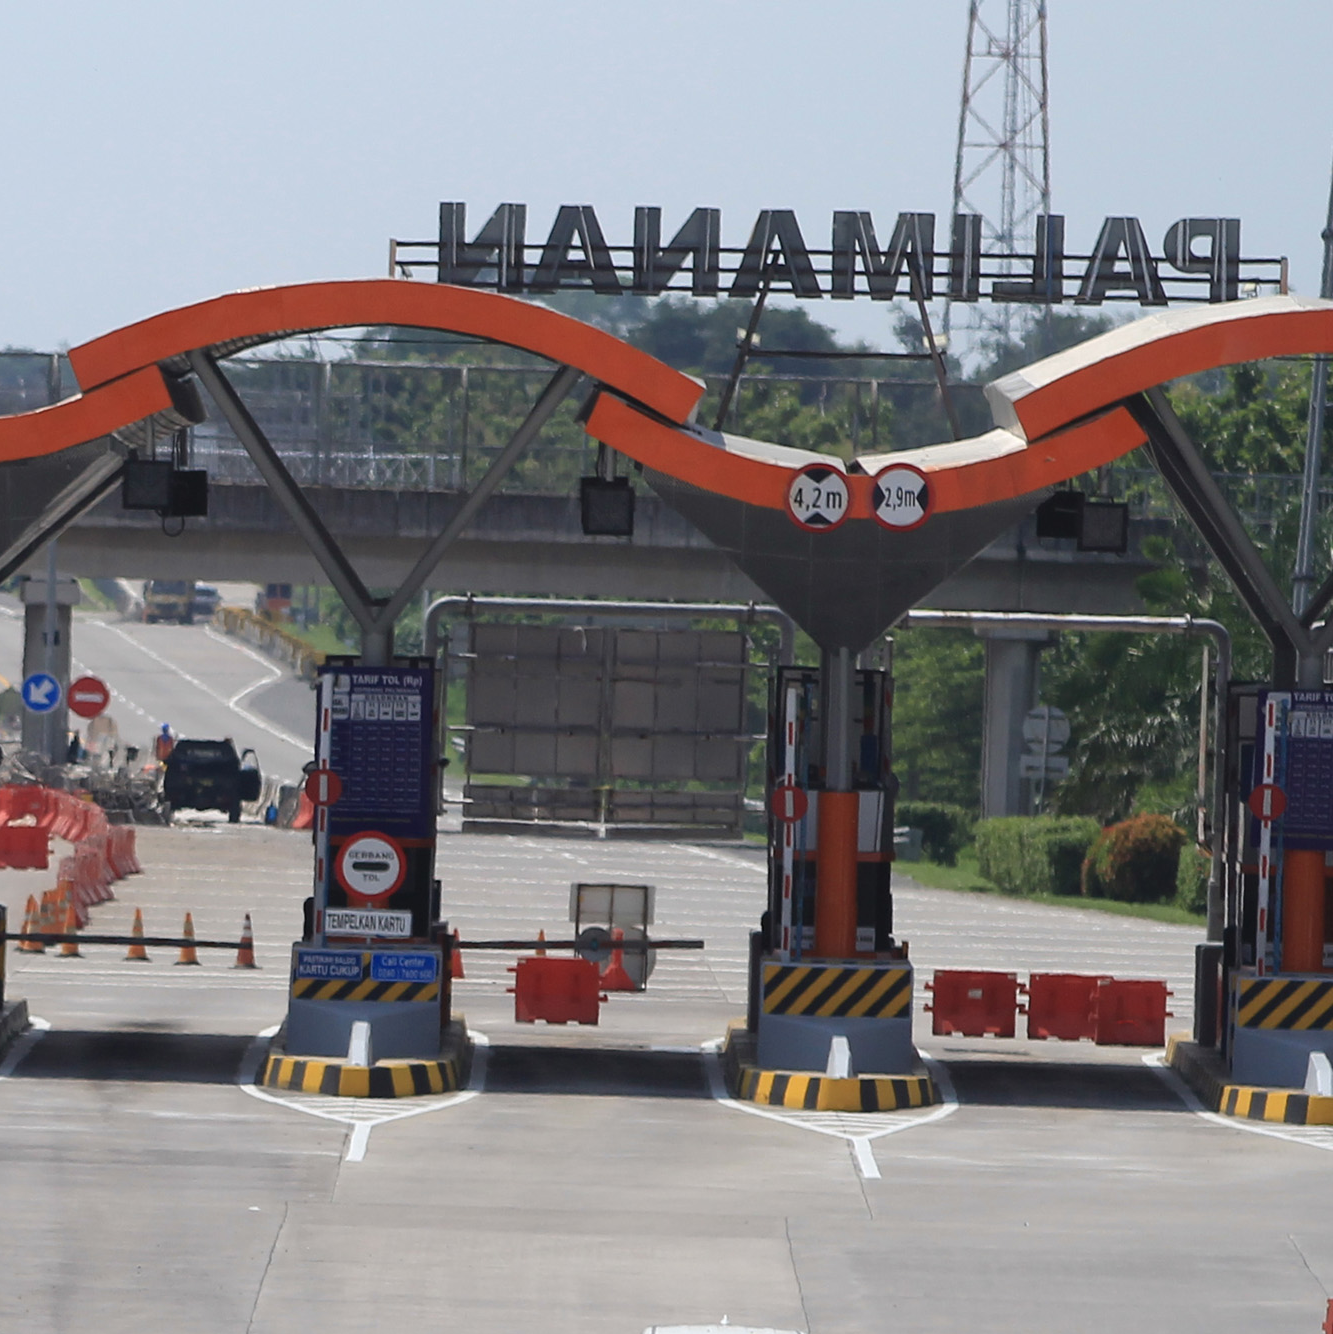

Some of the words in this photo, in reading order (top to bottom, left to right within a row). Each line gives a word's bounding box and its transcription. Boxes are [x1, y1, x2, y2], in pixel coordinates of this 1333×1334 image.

[352, 675, 380, 685] TARIF
[382, 676, 400, 686] TOL
[403, 676, 422, 686] (Rp)
[348, 852, 394, 860] GERBANG
[362, 874, 380, 882] TOL
[328, 914, 376, 930] TEMPELKAN
[378, 917, 406, 932] KARTU
[382, 958, 396, 966] Call
[400, 958, 425, 966] Center
[300, 965, 328, 976] KARTU
[330, 966, 360, 976] CUKUP
